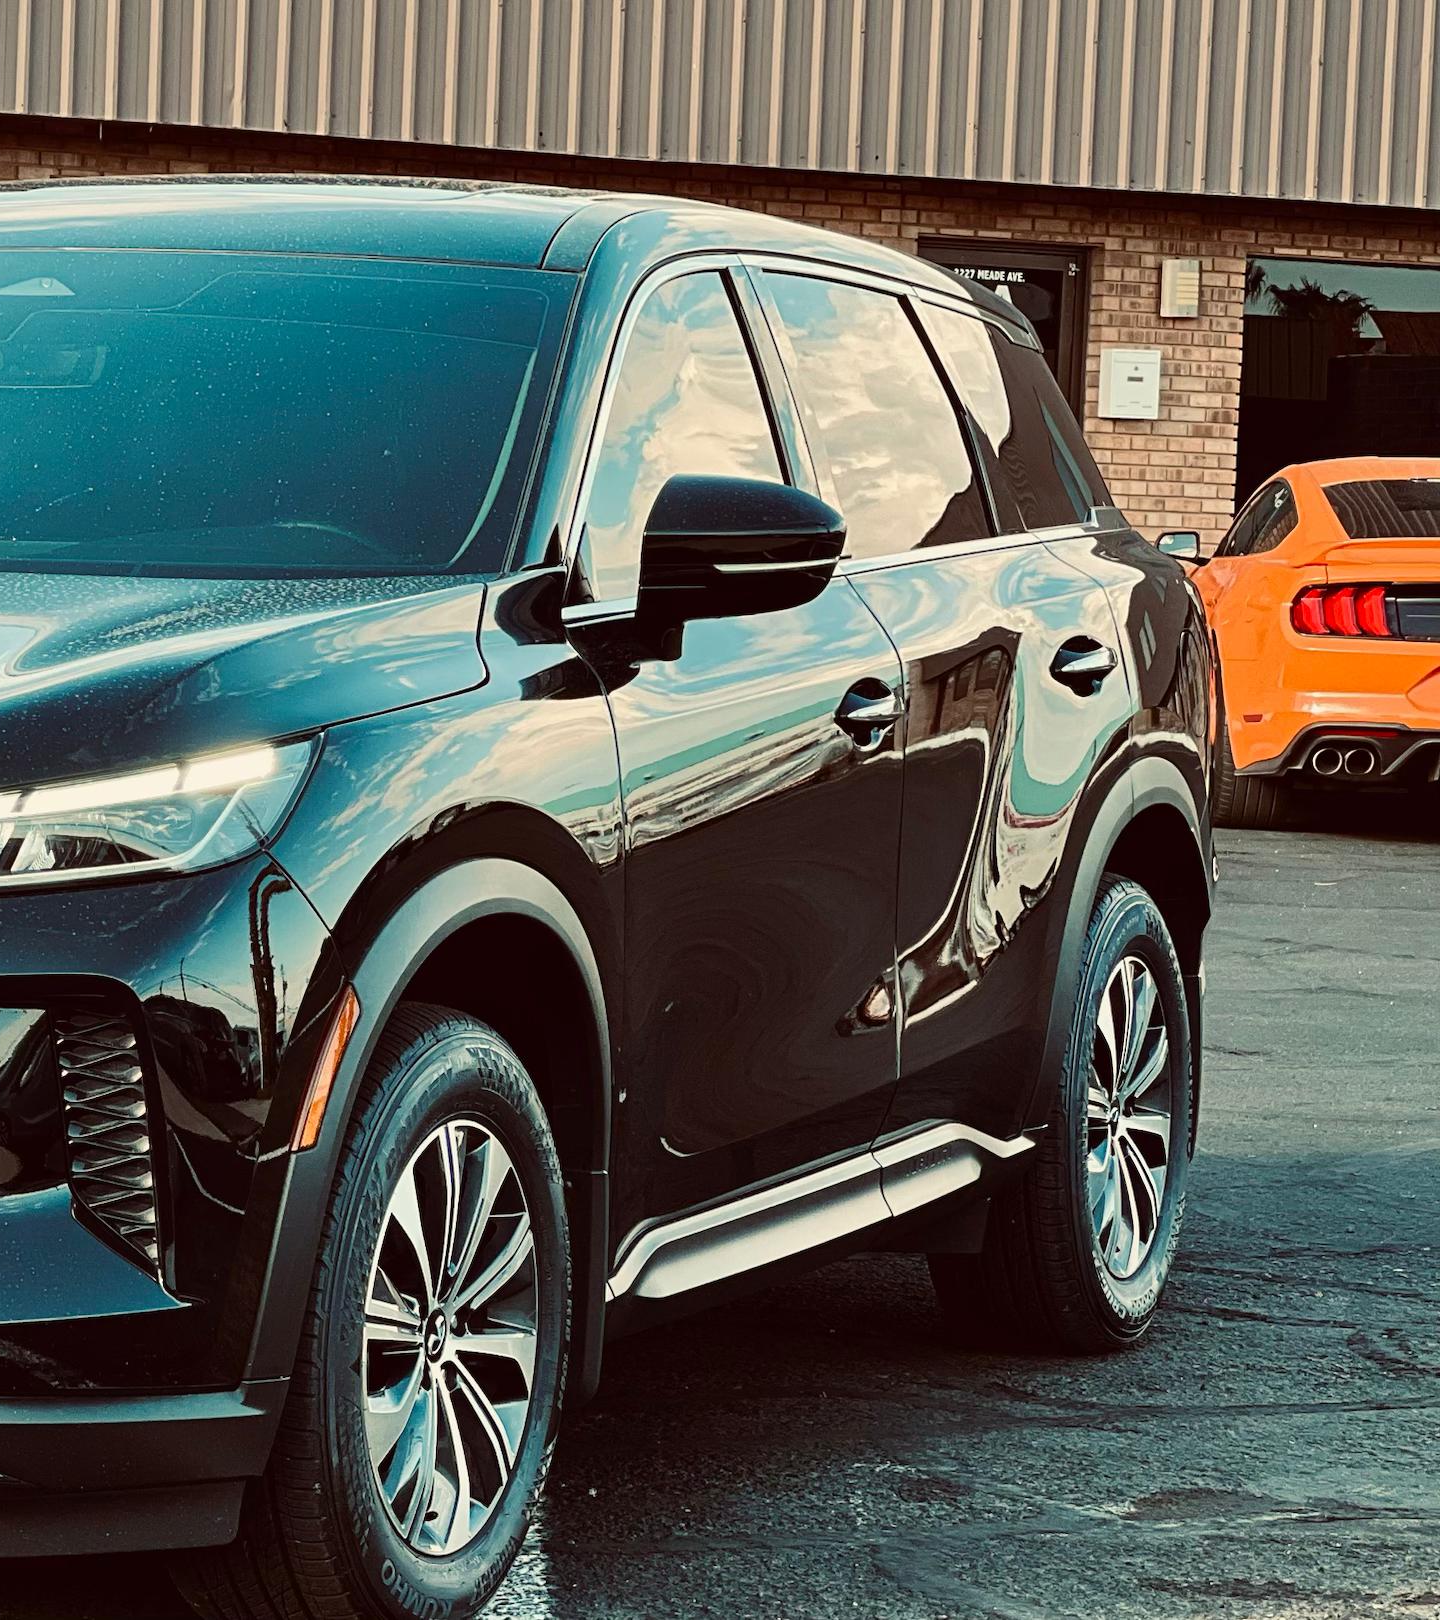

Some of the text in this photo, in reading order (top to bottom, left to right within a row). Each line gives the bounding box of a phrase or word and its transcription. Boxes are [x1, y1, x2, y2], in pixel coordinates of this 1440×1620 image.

[977, 269, 1006, 281] MEADE
[1006, 271, 1026, 283] AVE.
[380, 1558, 453, 1620] KUMHO
